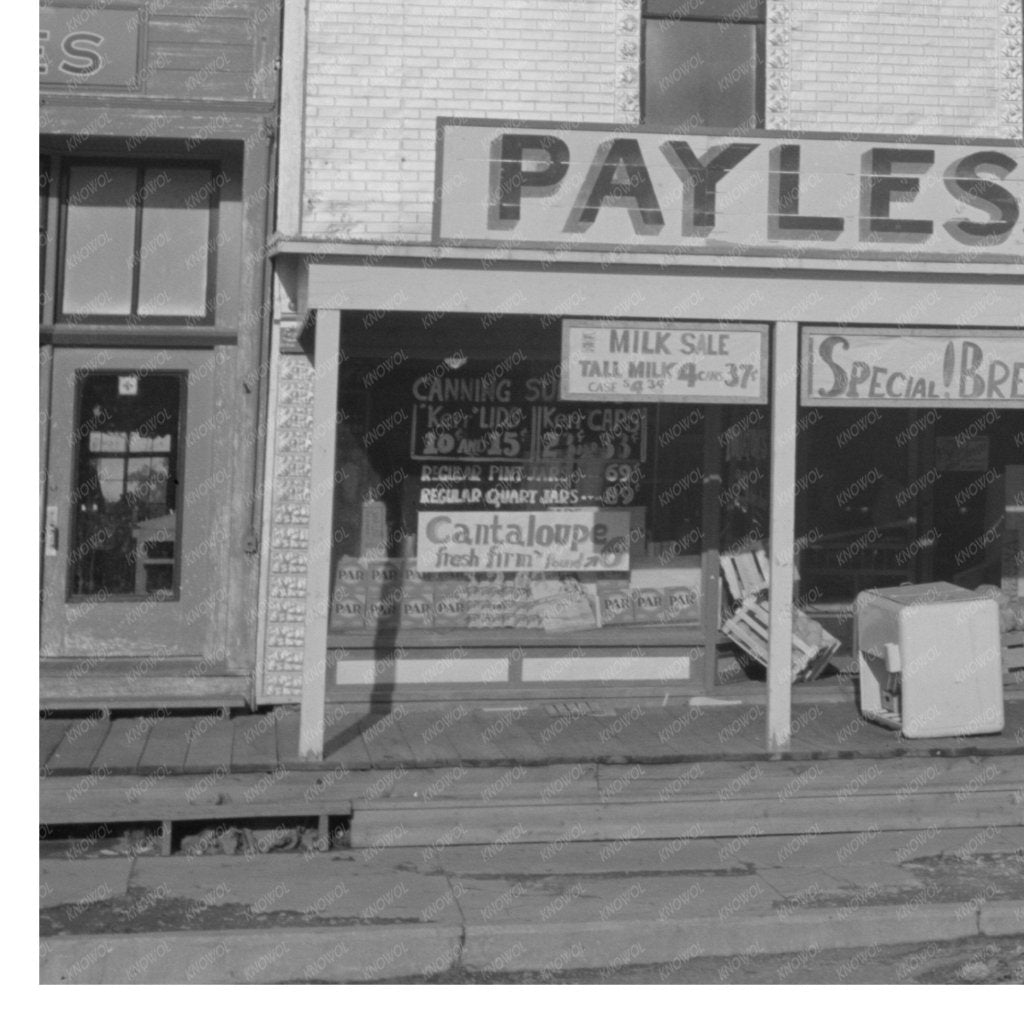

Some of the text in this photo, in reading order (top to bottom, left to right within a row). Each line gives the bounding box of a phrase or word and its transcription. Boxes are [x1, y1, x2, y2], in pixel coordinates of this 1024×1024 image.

[609, 329, 672, 355] MILK
[679, 332, 730, 356] SALE
[578, 360, 624, 378] TALL
[628, 361, 678, 379] MILK
[677, 362, 698, 388] 4
[412, 376, 511, 402] CANNING
[479, 406, 523, 429] LIDS
[587, 408, 640, 433] CAPS
[420, 465, 482, 482] REGULAR
[488, 465, 524, 482] PINT
[419, 487, 482, 505] REGULAR
[485, 488, 538, 508] QUART
[539, 489, 579, 505] JARS
[425, 514, 608, 552] Cantaloupe
[435, 546, 480, 568] fresh
[335, 603, 362, 615] PAR
[404, 603, 430, 615] PAR
[438, 602, 465, 614] PAR
[604, 598, 630, 610] PAR
[637, 596, 663, 608] PAR
[669, 594, 695, 606] PAR
